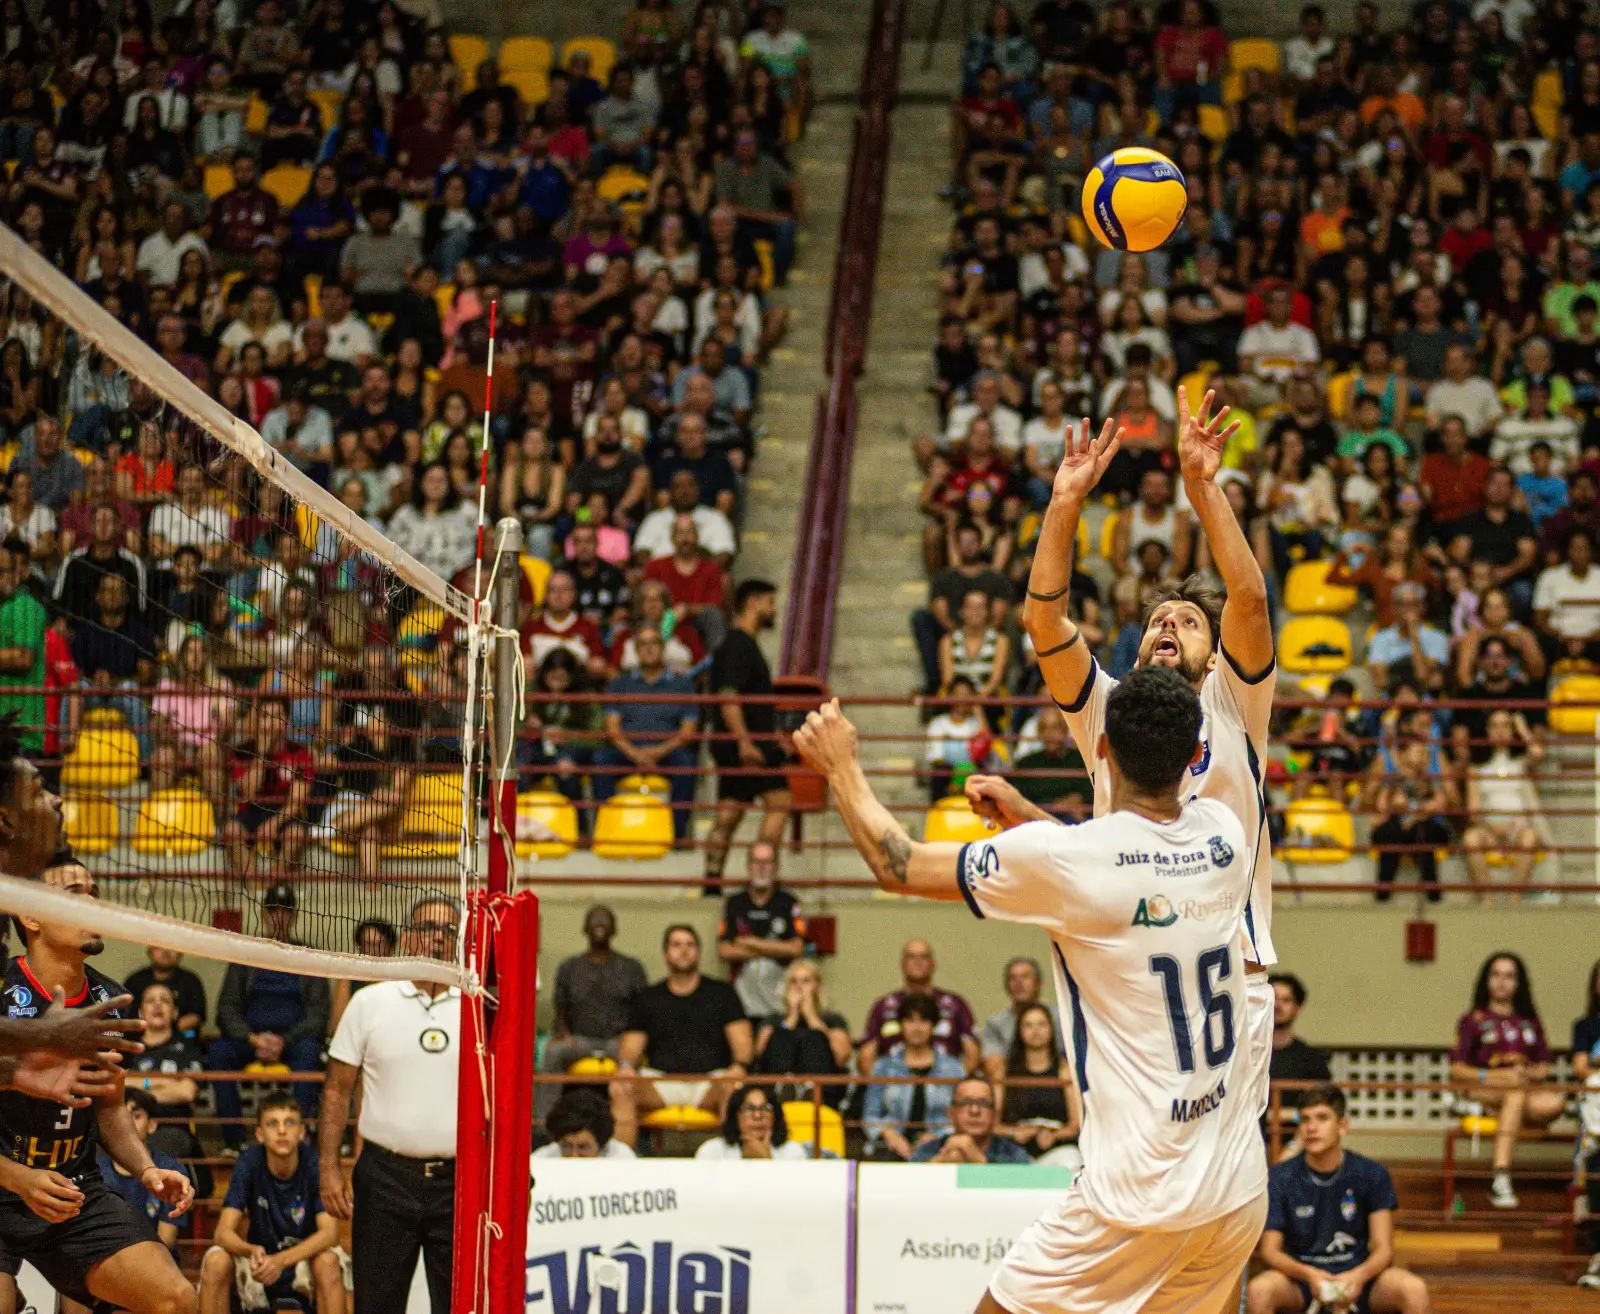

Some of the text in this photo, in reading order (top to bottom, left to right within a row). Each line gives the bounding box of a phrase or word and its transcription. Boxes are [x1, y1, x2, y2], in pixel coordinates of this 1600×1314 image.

[1115, 849, 1206, 867] Juiz de Fora
[1155, 863, 1209, 878] Prefeitura
[1148, 944, 1236, 1075] 16
[535, 1188, 678, 1224] SÓCIO TORCEDOR
[900, 1237, 981, 1260] Assine
